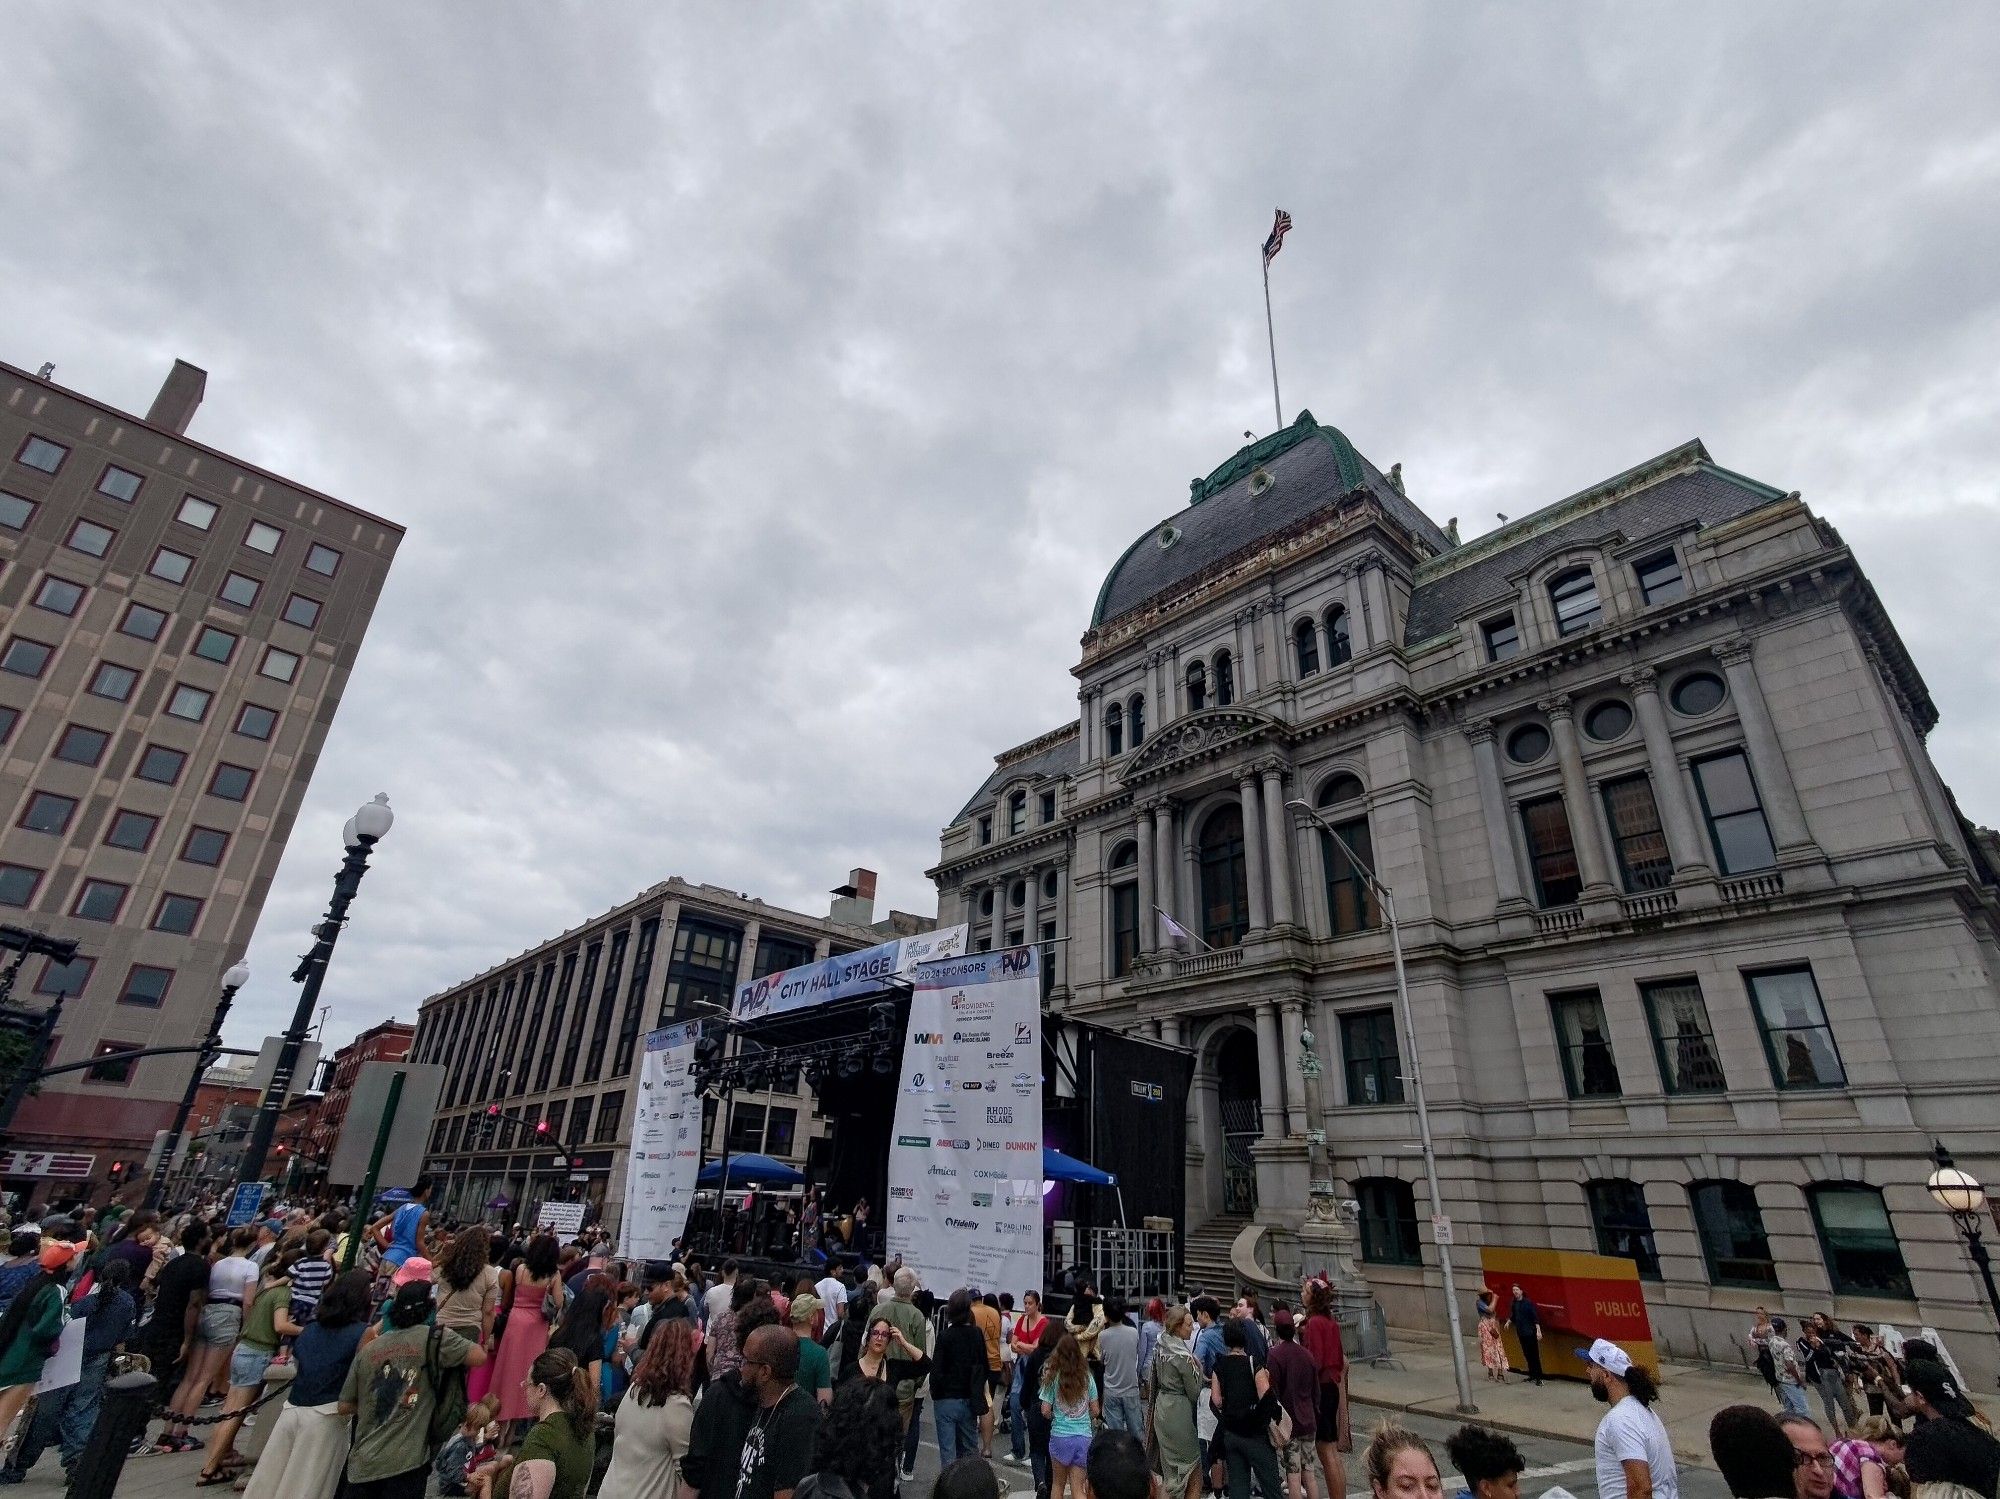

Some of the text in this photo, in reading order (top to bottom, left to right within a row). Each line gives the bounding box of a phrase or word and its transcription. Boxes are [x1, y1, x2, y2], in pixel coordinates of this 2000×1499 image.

[1001, 949, 1031, 975] PVD
[919, 969, 941, 980] 2024
[941, 962, 987, 979] SPONSORS
[780, 977, 808, 1000] CITY
[809, 972, 841, 993] HALL
[843, 956, 892, 983] STAGE
[738, 980, 770, 1016] PVD
[959, 1000, 995, 1010] PROVIDENCE
[914, 1033, 944, 1045] WM
[986, 1052, 1015, 1060] Breeze
[986, 1106, 1013, 1116] RHODE
[986, 1115, 1013, 1124] ISLAND
[982, 1141, 1000, 1149] DIMEO
[927, 1164, 957, 1177] Amica
[973, 1170, 989, 1179] COX
[953, 1219, 980, 1231] Fidelity
[1003, 1222, 1032, 1231] PAOLINO
[1593, 1300, 1641, 1318] PUBLIC
